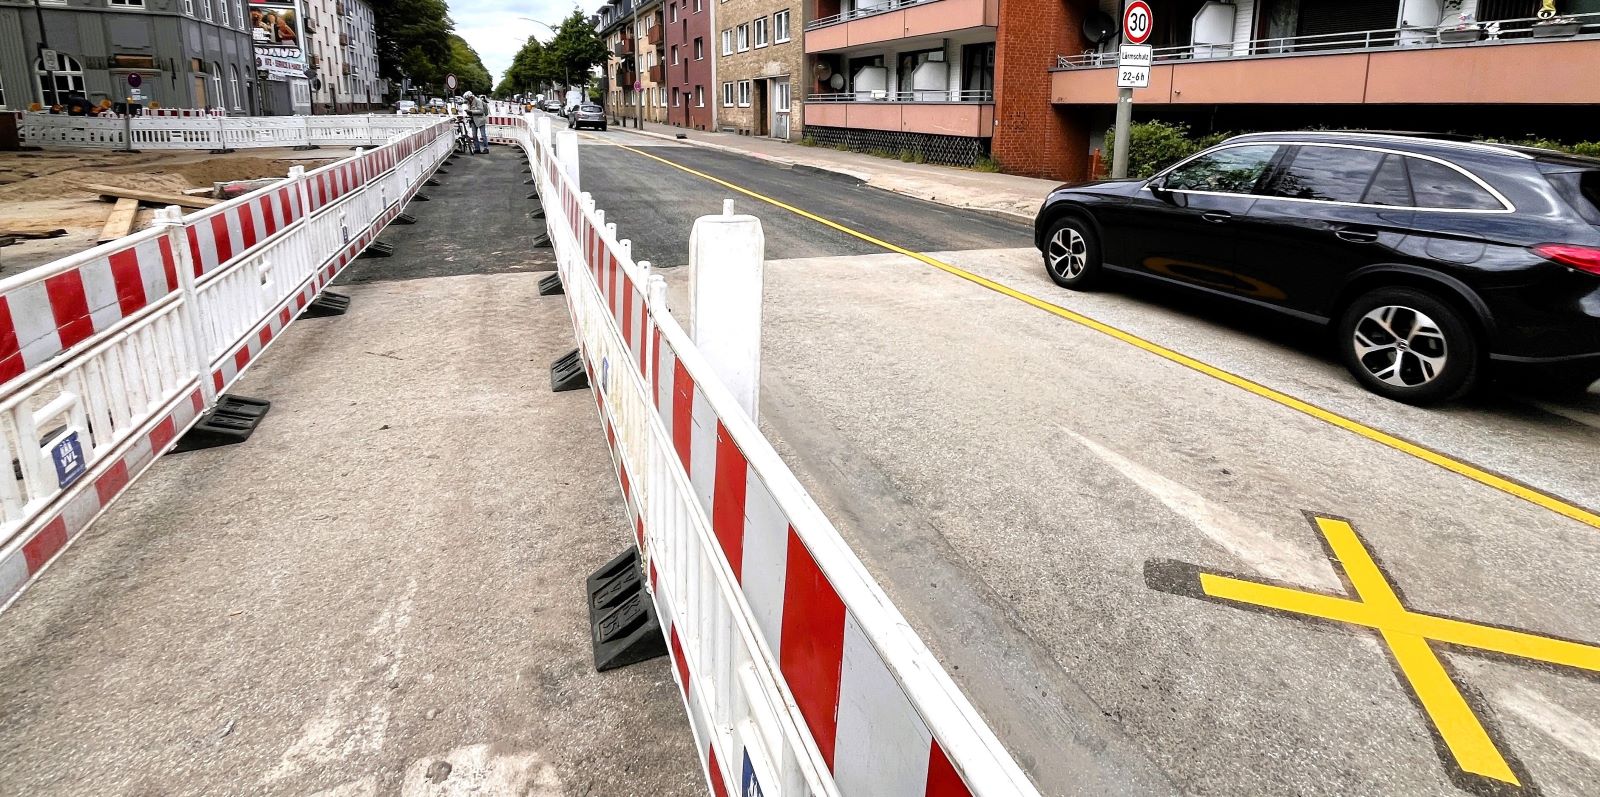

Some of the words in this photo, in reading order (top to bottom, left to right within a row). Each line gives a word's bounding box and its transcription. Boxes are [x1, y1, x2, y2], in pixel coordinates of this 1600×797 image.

[1129, 13, 1147, 32] 30
[1121, 51, 1149, 61] Lärmschutz
[60, 450, 78, 467] VVL
